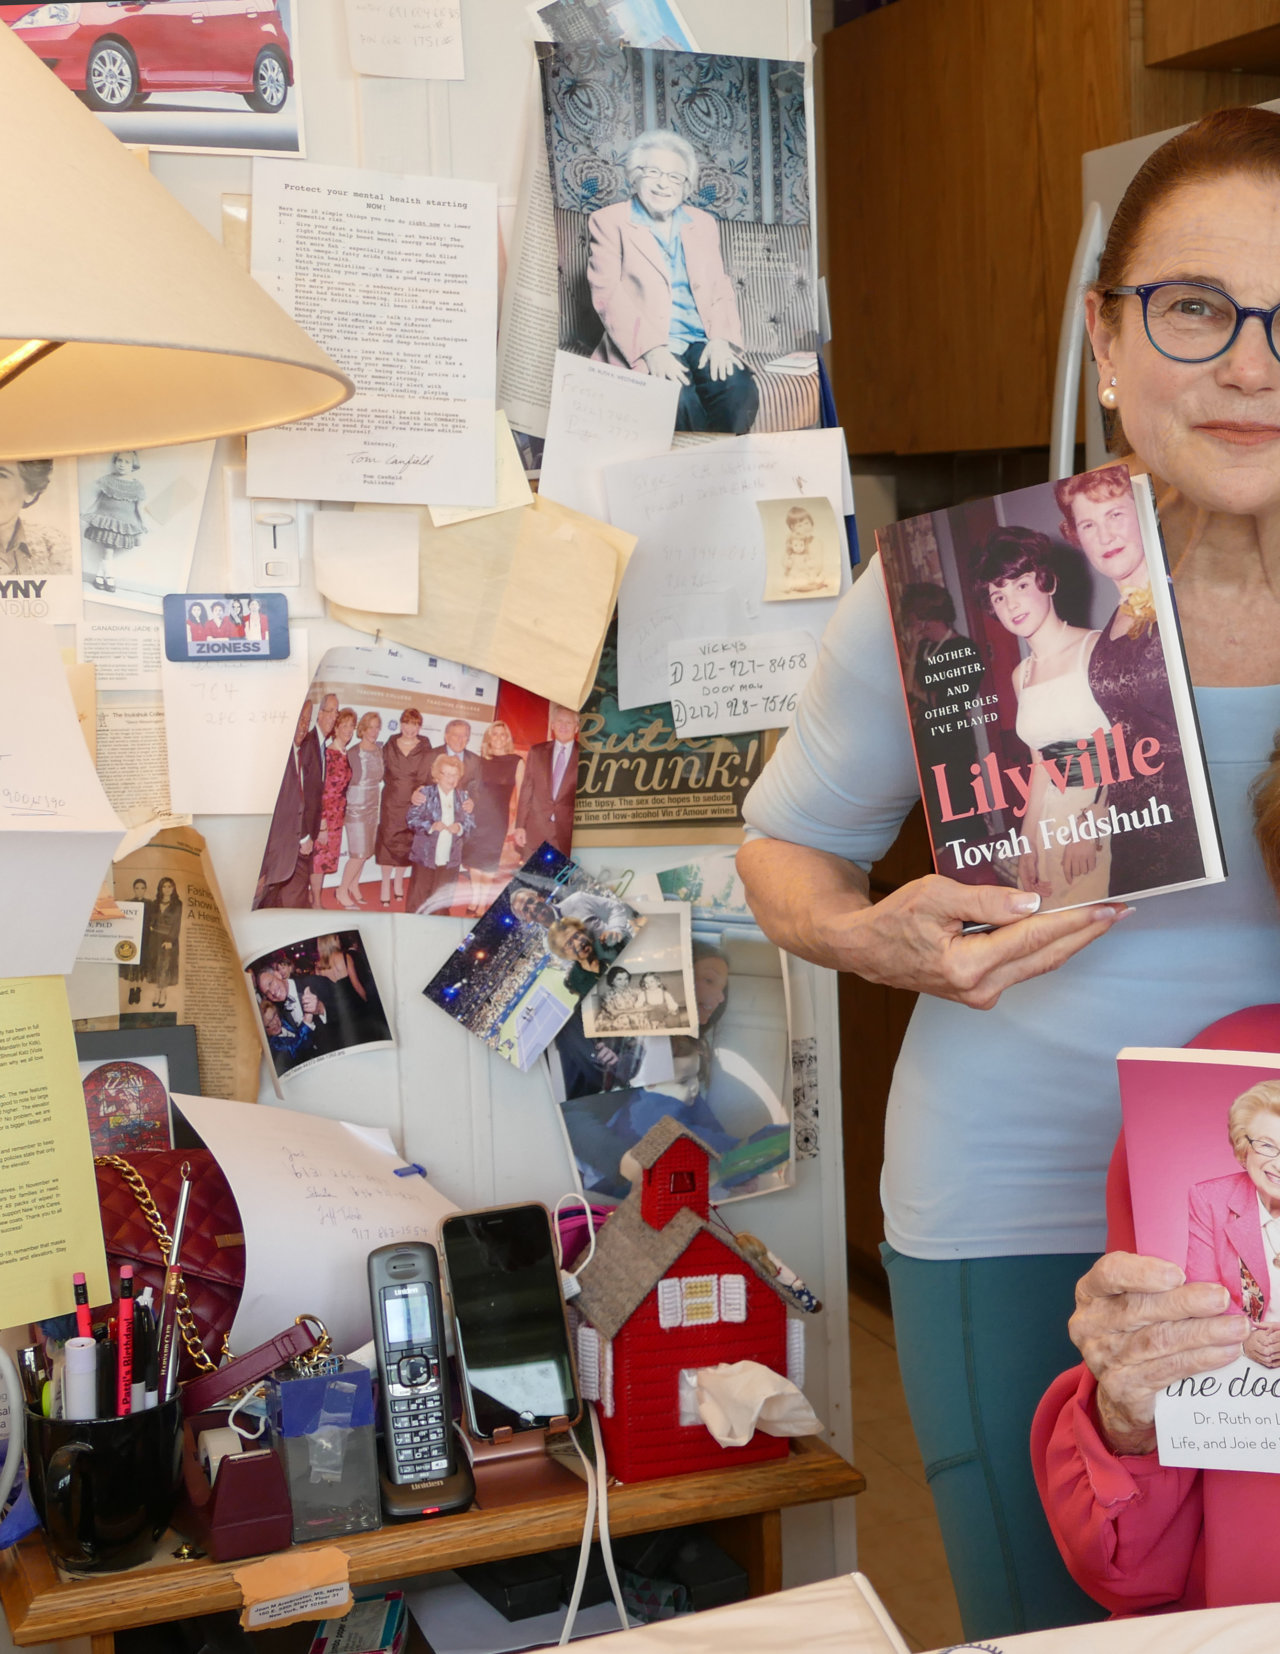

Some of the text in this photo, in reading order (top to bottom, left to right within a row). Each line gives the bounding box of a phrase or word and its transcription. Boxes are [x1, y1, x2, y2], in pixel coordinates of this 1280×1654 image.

[284, 182, 468, 209] Protect your mental health starting
[366, 202, 387, 211] NOW!
[196, 641, 261, 655] ZIONESS
[946, 683, 970, 697] AND
[924, 694, 999, 720] OTHER ROLES
[930, 712, 998, 736] I'VE PLAYED
[931, 723, 1166, 823] Lilyville
[619, 797, 633, 806] The
[651, 796, 666, 805] doc
[667, 796, 692, 807] hopes
[692, 795, 700, 803] to
[702, 793, 731, 803] seduce
[584, 812, 600, 821] line
[602, 811, 610, 820] of
[612, 809, 659, 820] low-alcohol
[660, 808, 673, 817] Vin
[675, 807, 708, 817] d'Amour
[710, 806, 735, 816] wines
[945, 796, 1173, 870] Tovah Feldshuh
[121, 1318, 133, 1405] Patti's Birthday!
[160, 1344, 169, 1376] HARVARD
[1194, 1411, 1215, 1425] Dr.
[1218, 1411, 1251, 1425] Ruth
[1254, 1415, 1272, 1425] on
[1170, 1436, 1200, 1451] Life,
[1203, 1436, 1227, 1450] and
[1230, 1436, 1257, 1450] Joie
[1260, 1437, 1277, 1450] de
[411, 1479, 444, 1490] Uniden
